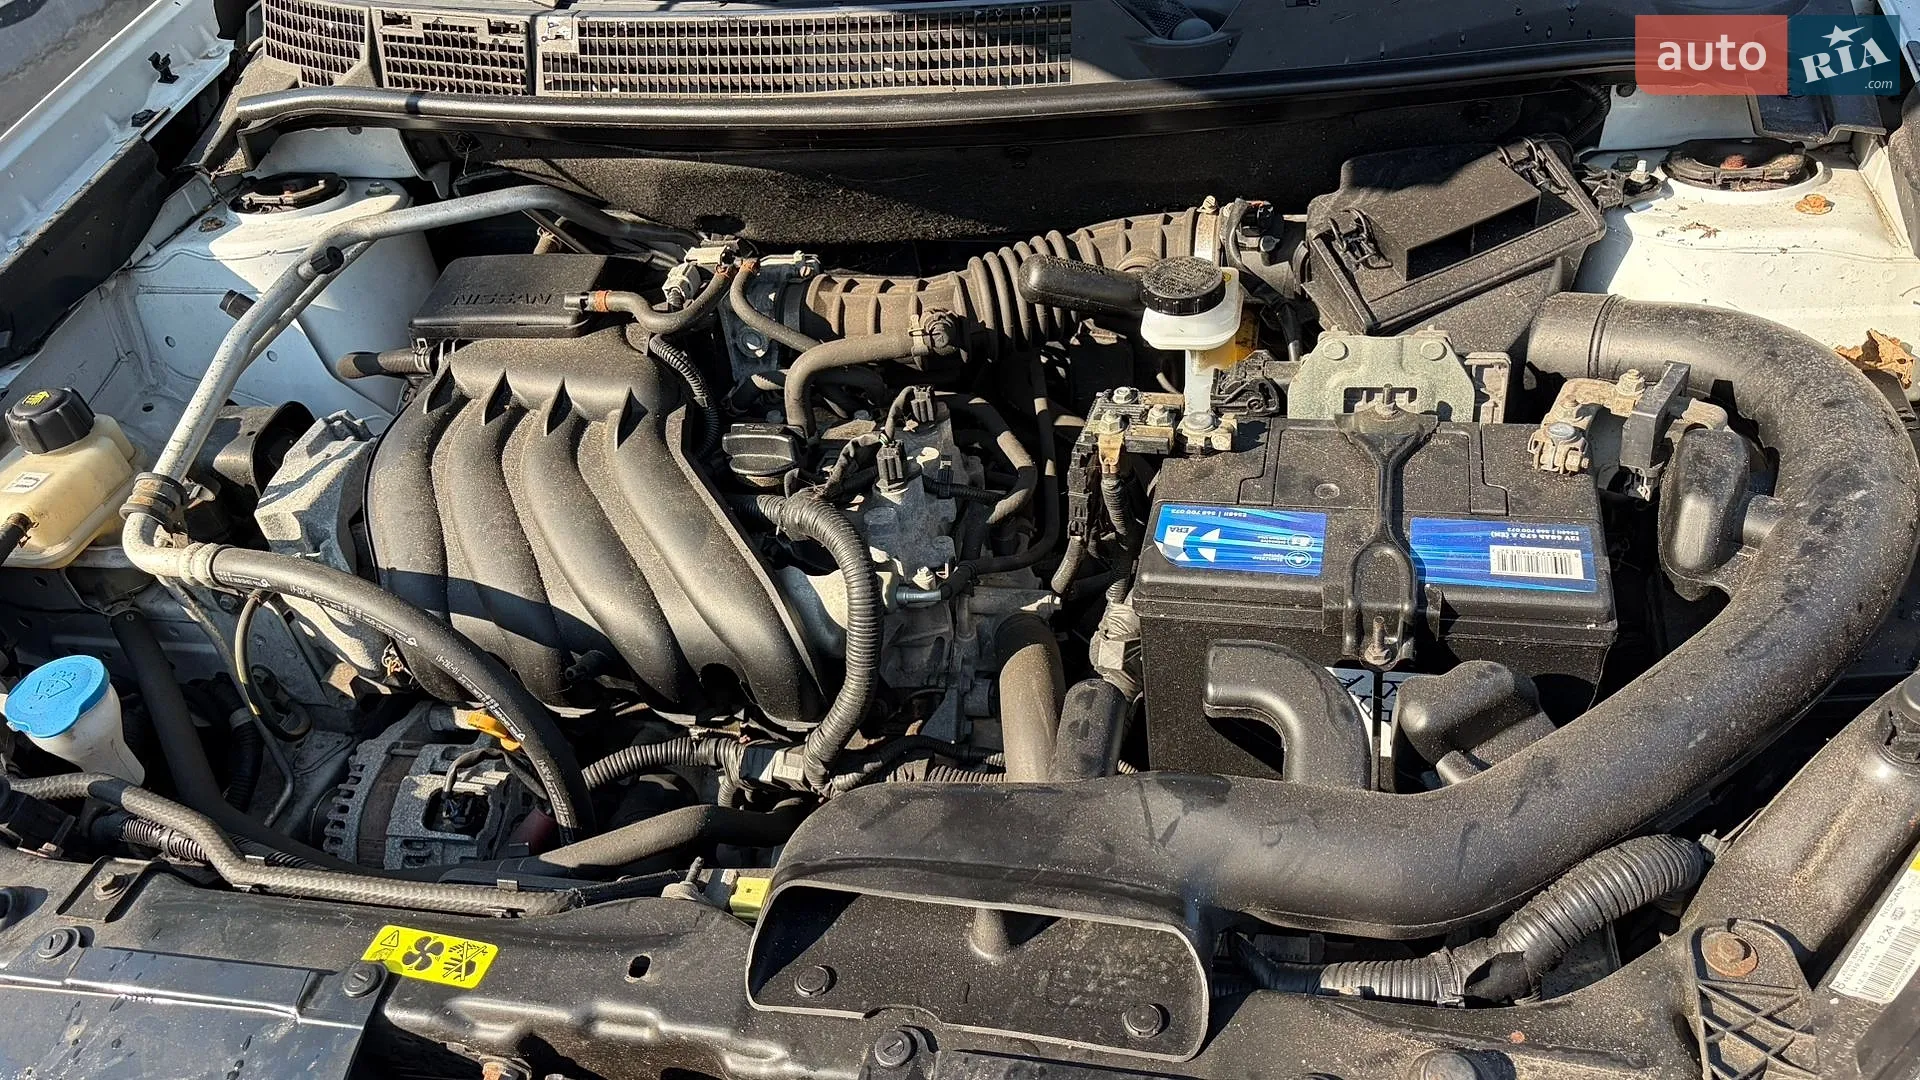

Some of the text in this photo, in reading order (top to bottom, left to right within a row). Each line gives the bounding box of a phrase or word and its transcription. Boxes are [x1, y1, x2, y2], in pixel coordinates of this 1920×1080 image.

[452, 293, 552, 306] NISSAN
[1169, 526, 1190, 534] ERA
[1880, 886, 1906, 917] NISSAN
